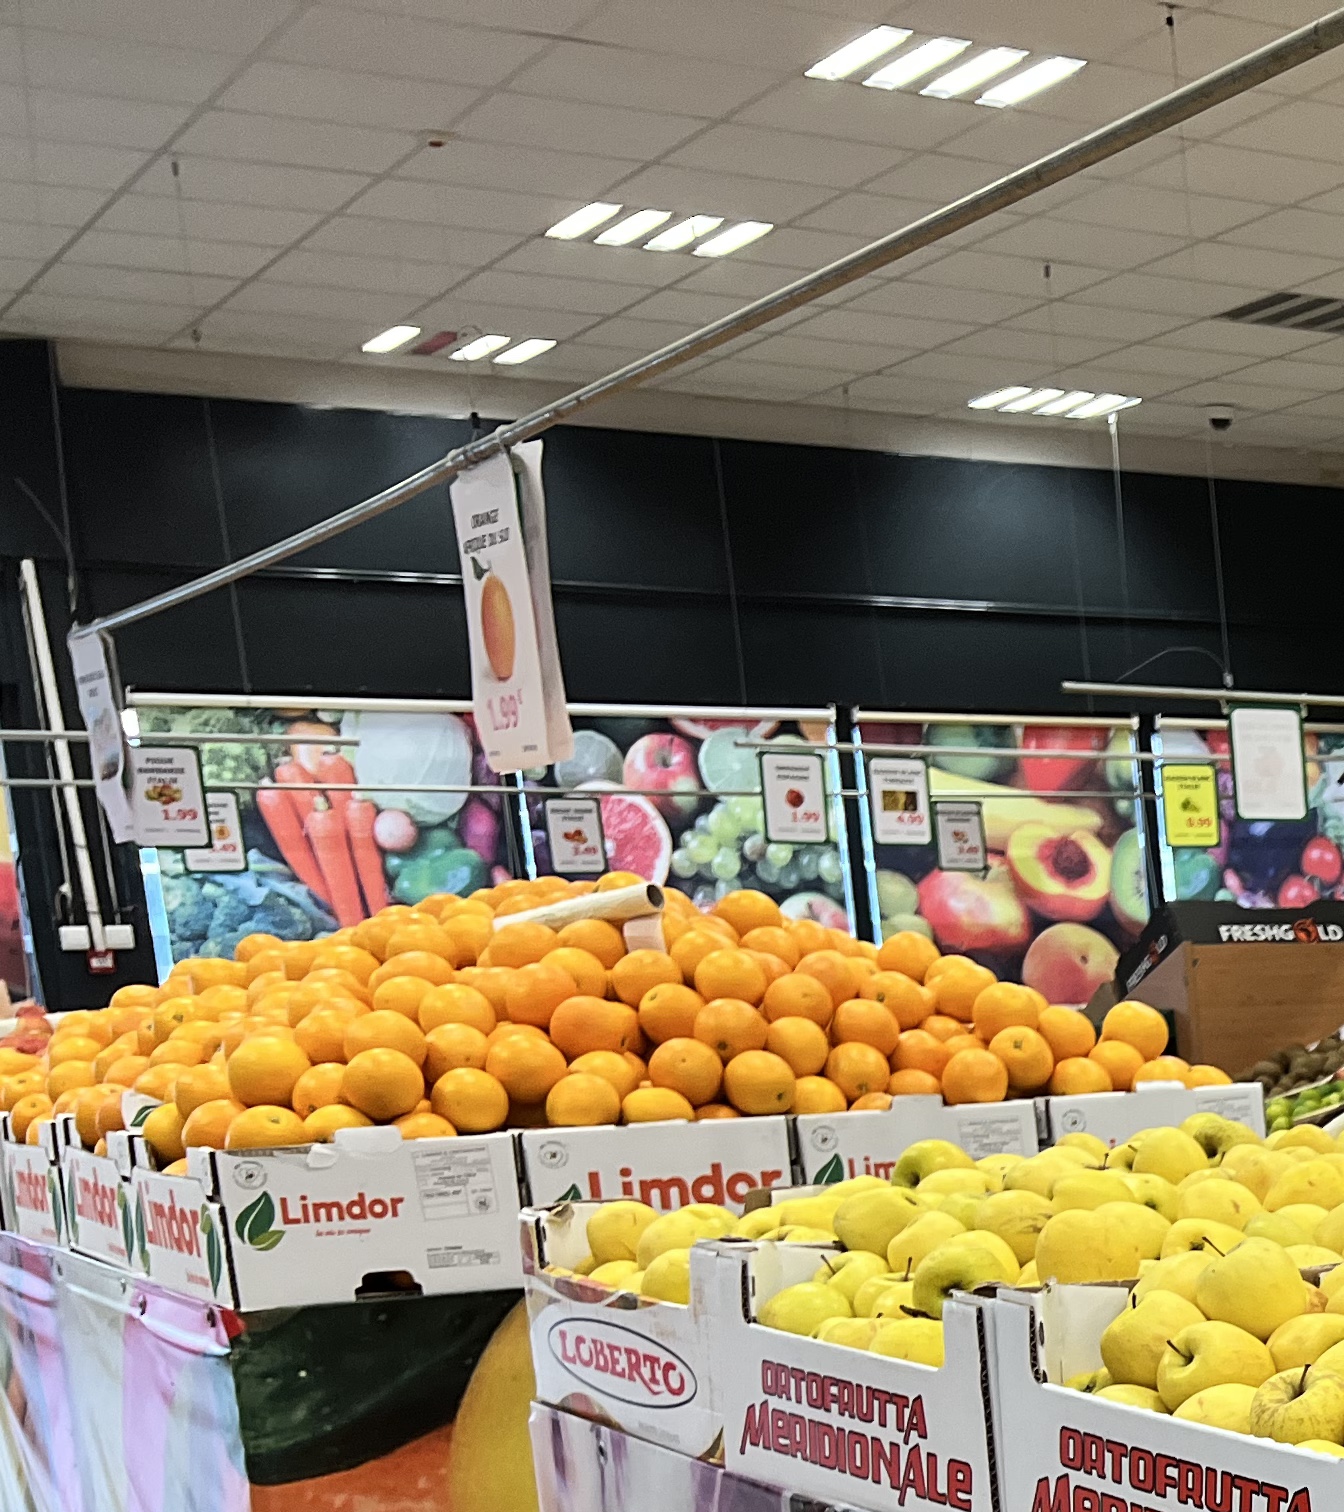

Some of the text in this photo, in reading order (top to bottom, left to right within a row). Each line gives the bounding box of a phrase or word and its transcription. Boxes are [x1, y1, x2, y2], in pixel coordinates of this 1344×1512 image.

[280, 1192, 405, 1225] Limdor
[558, 1329, 685, 1396] LOBERTO
[761, 1358, 928, 1446] ORTOFRUTTA
